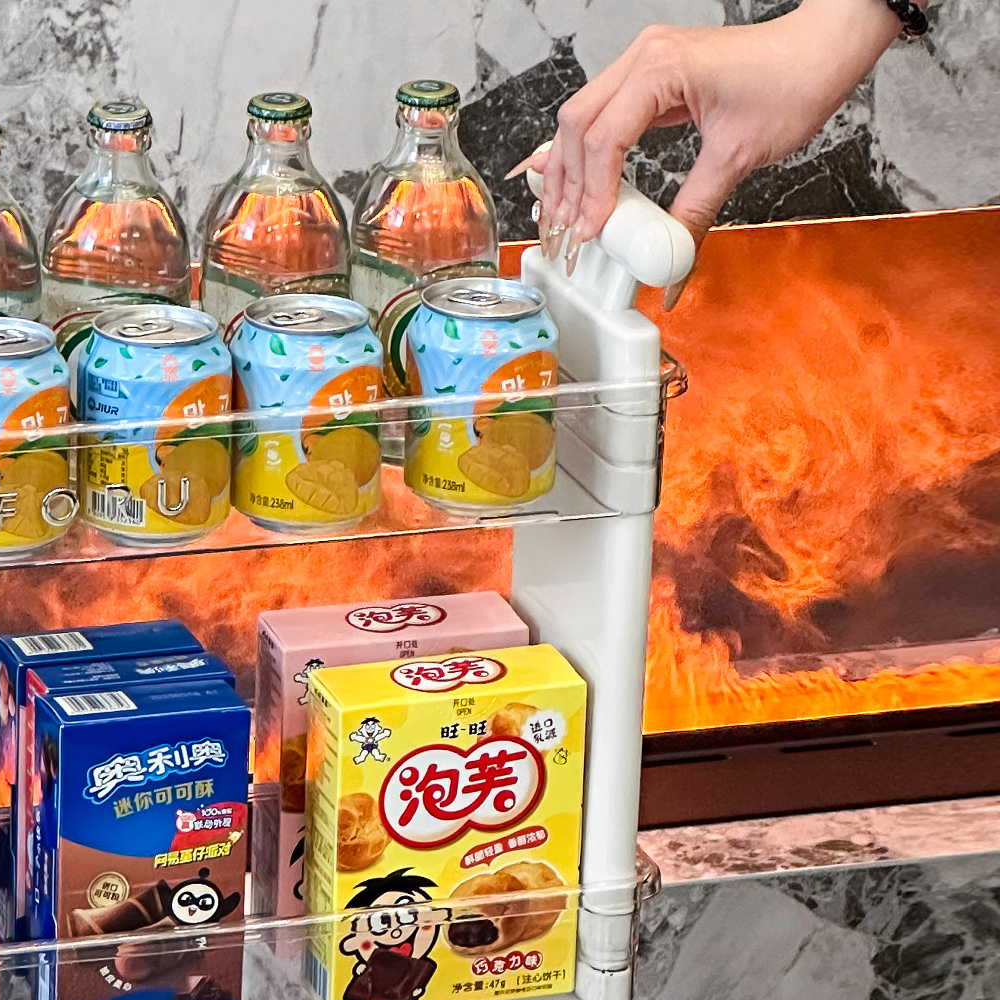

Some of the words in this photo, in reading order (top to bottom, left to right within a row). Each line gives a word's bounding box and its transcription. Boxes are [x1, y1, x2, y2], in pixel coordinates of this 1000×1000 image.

[354, 605, 432, 628] 泡芙
[399, 658, 490, 686] 泡芙
[90, 740, 226, 798] 奥利奥
[113, 778, 215, 819] 迷你可可酥
[398, 749, 528, 828] 泡芙
[474, 954, 539, 974] 巧克力味
